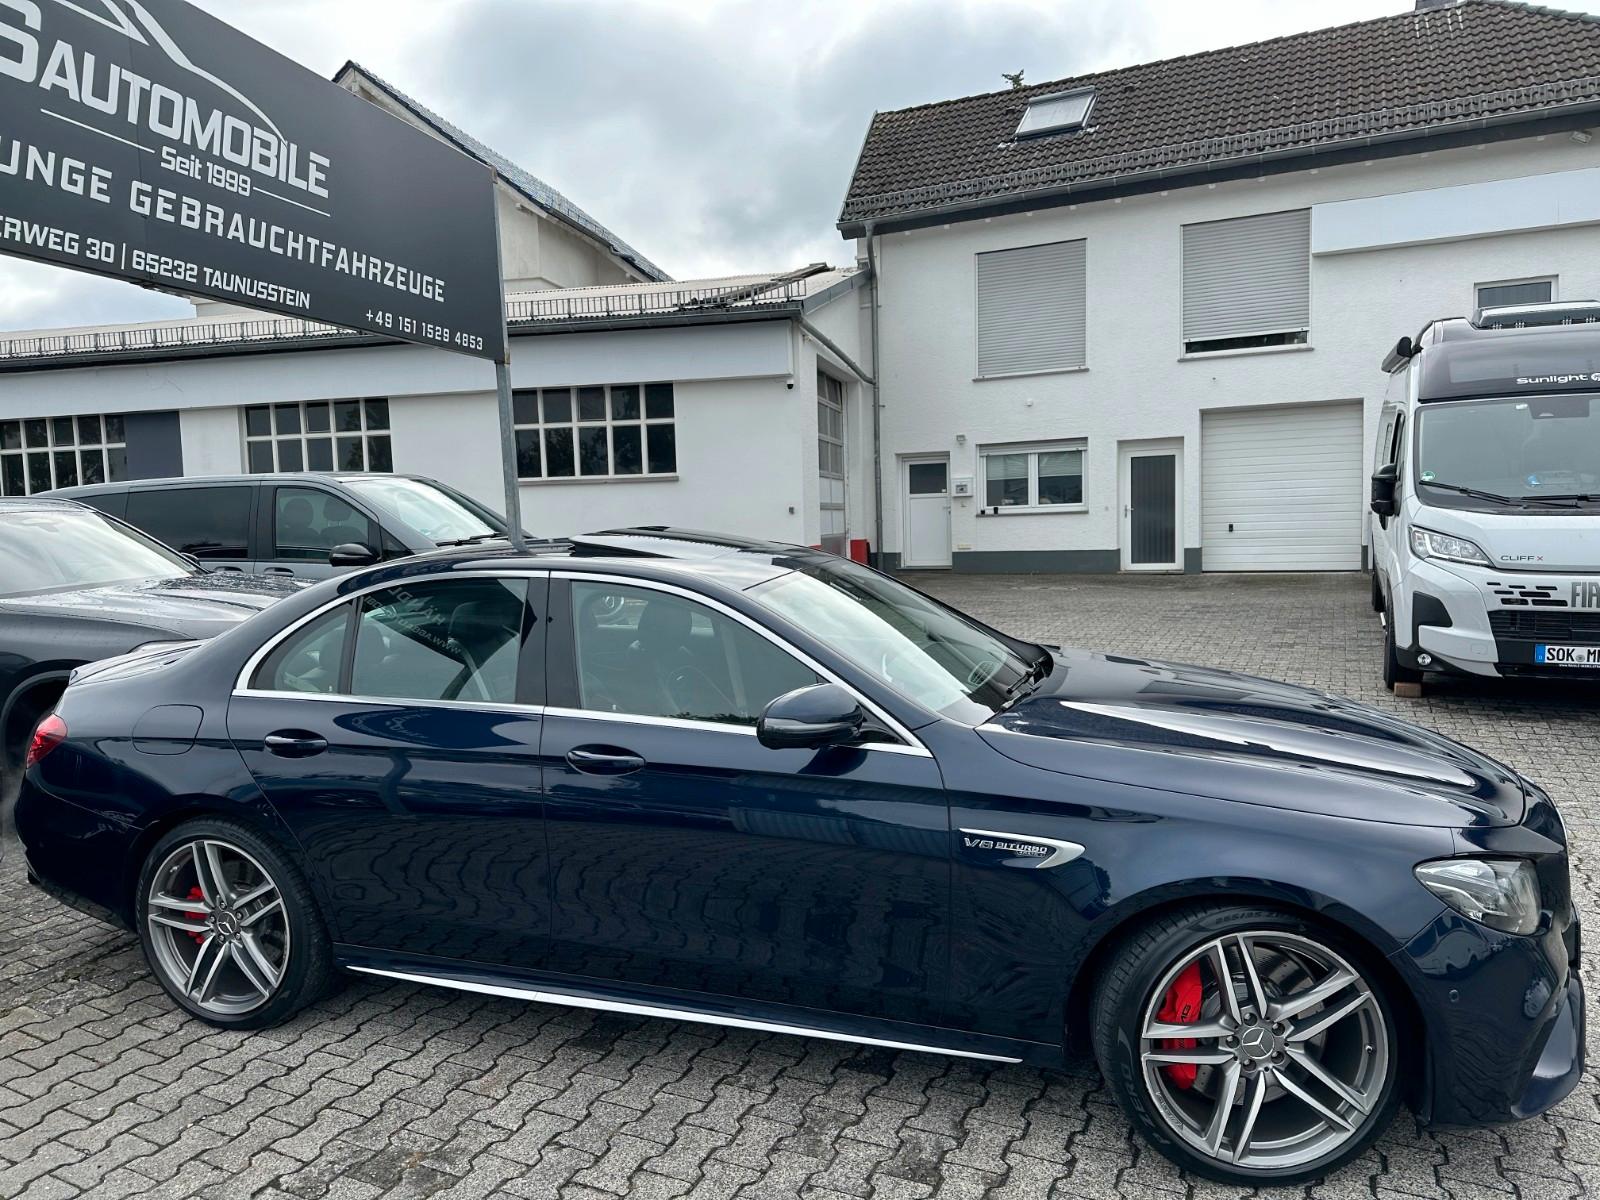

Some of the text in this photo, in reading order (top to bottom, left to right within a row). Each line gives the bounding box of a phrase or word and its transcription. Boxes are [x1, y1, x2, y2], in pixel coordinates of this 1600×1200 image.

[161, 146, 251, 197] Seit 1999
[0, 216, 80, 255] RWEG
[86, 237, 115, 263] 30
[132, 249, 198, 283] 65232
[203, 267, 310, 309] TAUNUSSTEIN
[130, 180, 445, 302] GEBRAUCHTFAHRZEUGE
[366, 309, 483, 350] +49 151 1529 4853
[1546, 647, 1600, 663] SOK M
[964, 837, 993, 849] V8
[995, 841, 1048, 855] BITURBO
